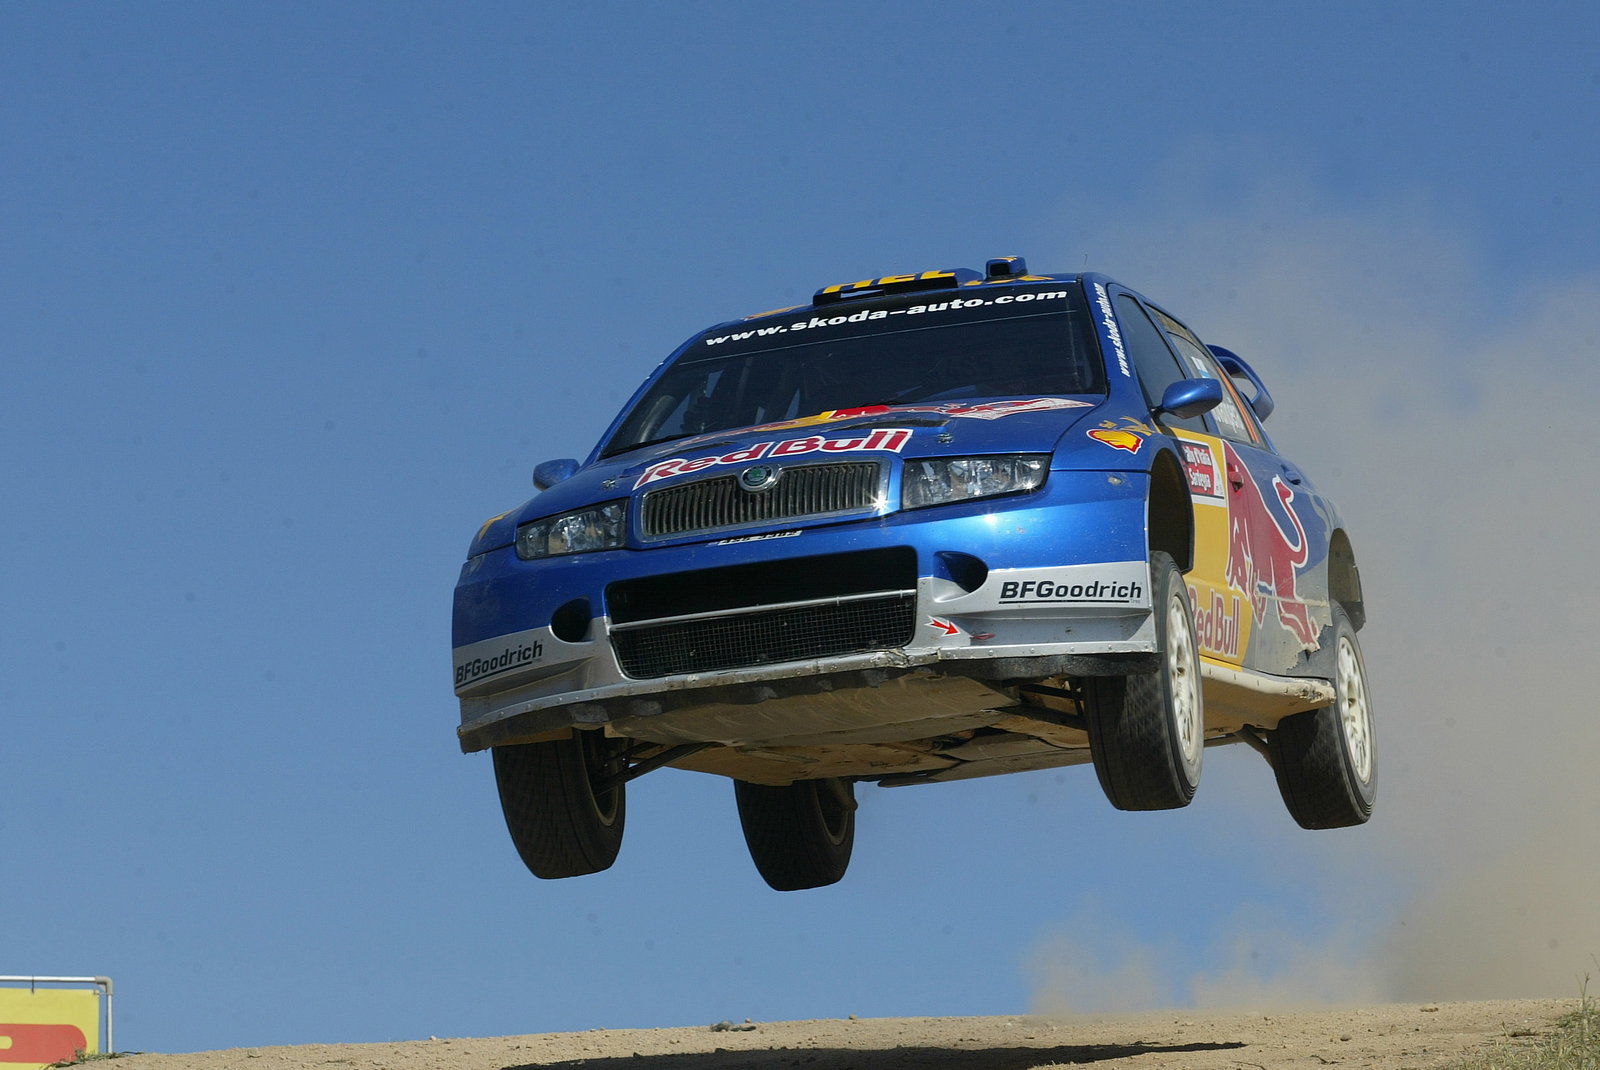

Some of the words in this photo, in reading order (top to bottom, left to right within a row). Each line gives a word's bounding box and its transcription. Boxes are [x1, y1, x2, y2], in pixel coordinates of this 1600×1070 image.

[705, 290, 1069, 347] www.skoda-auto.com
[631, 441, 776, 491] Red
[767, 428, 914, 458] Bull
[1000, 580, 1142, 599] BFGoodrich
[1213, 592, 1240, 658] Bull
[455, 639, 543, 684] BFGoodrich
